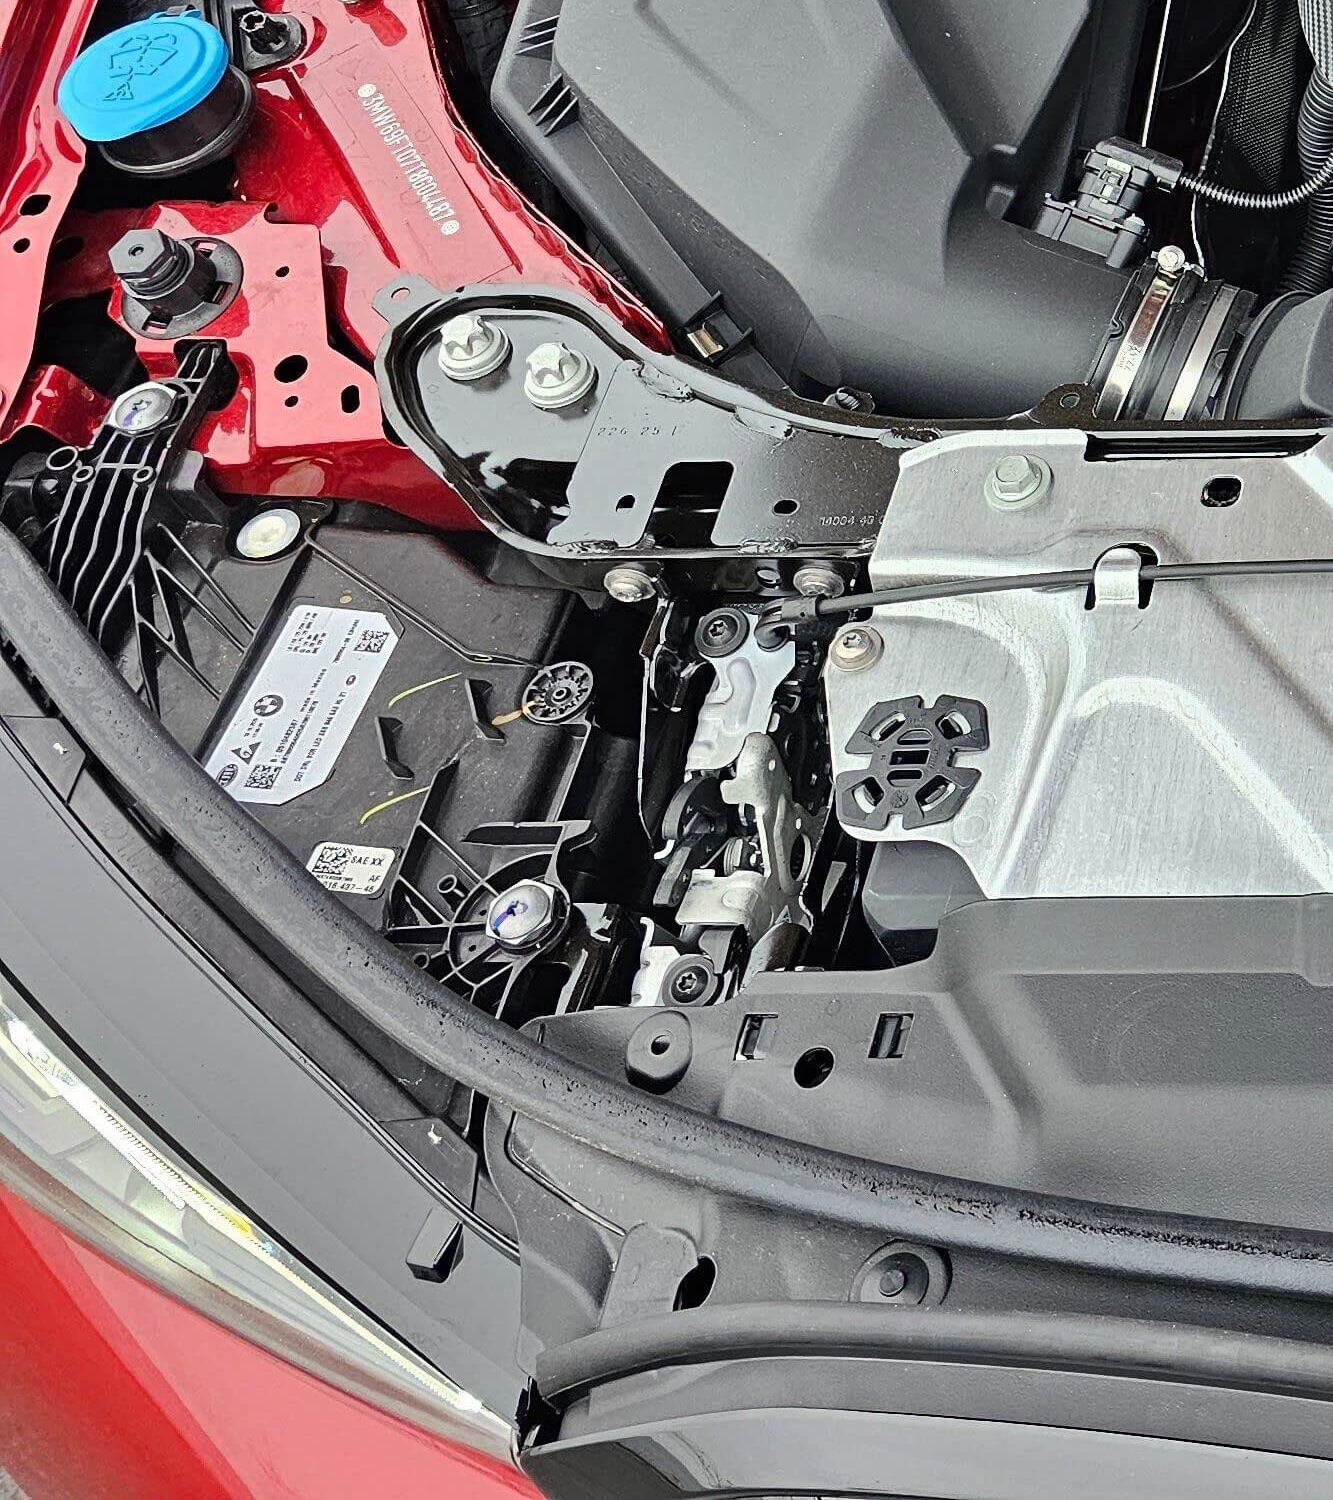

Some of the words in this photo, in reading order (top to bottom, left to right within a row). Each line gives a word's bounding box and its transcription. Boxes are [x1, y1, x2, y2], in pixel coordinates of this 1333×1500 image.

[350, 855, 369, 865] SAE
[371, 857, 384, 866] XX
[368, 874, 381, 883] AF
